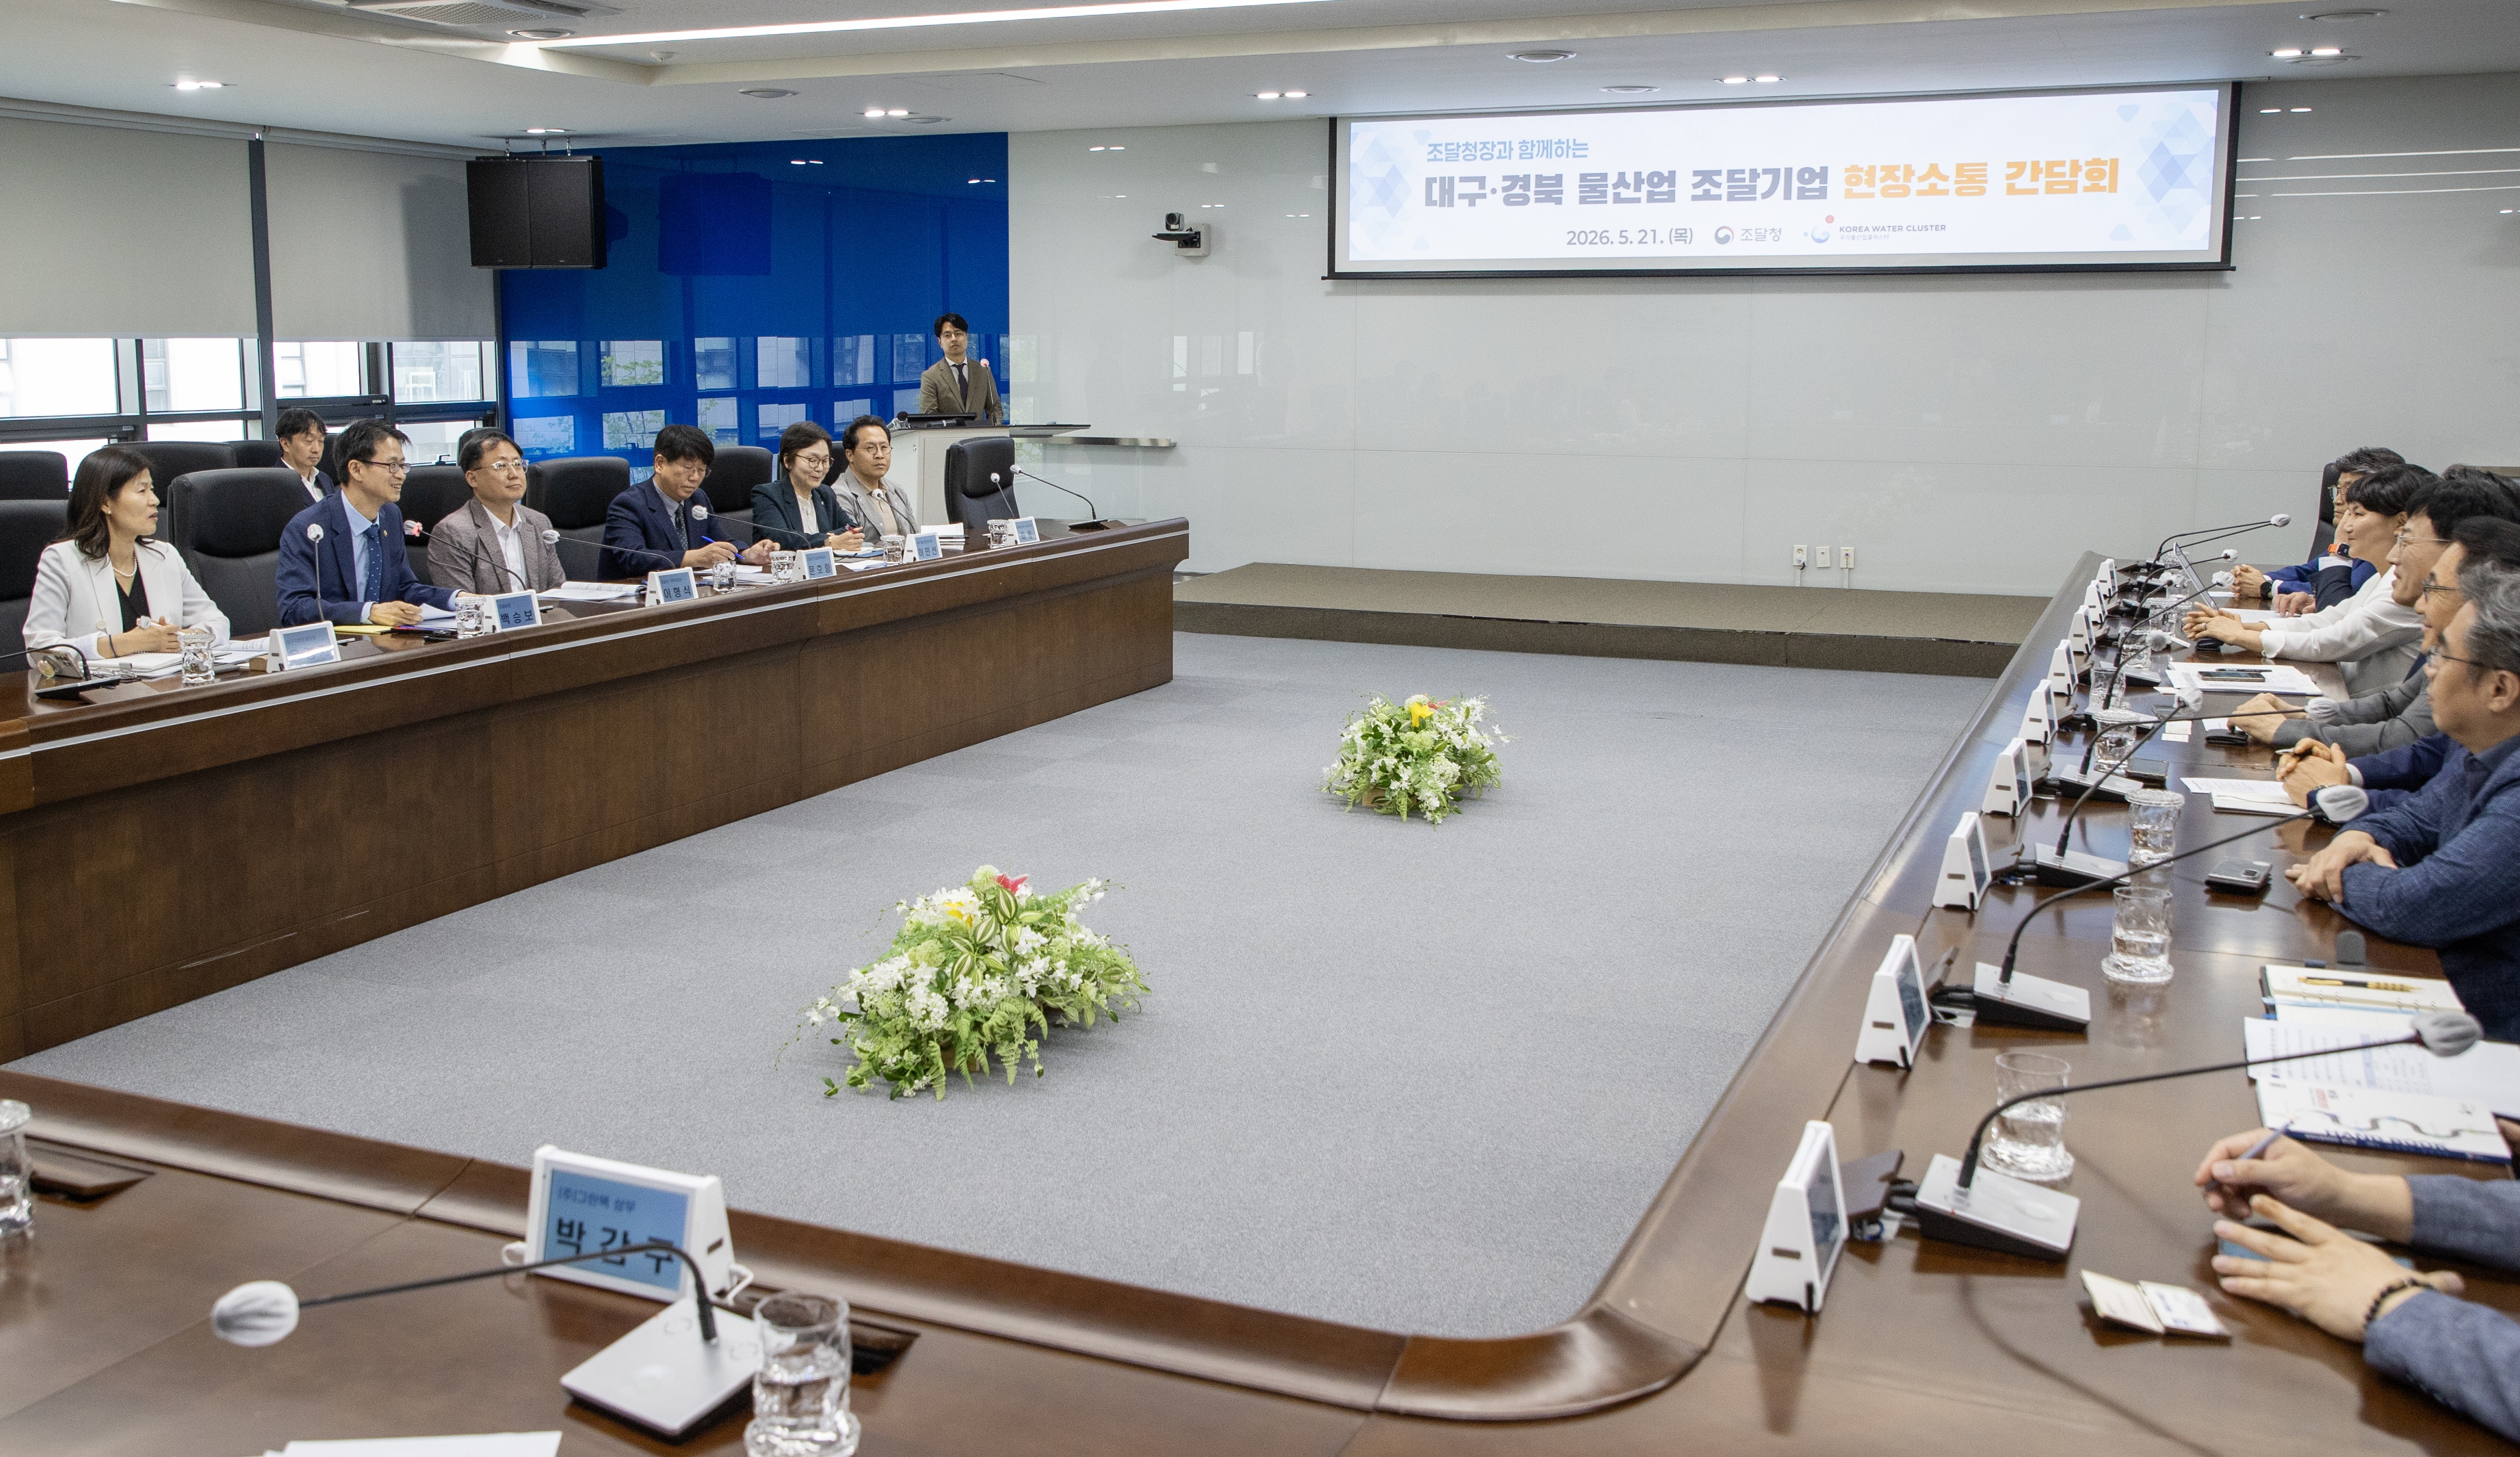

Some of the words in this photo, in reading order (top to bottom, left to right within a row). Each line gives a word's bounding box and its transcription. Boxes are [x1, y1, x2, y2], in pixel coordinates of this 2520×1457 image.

[1426, 140, 1514, 163] 조달청장과
[1518, 138, 1589, 160] 함께하는
[1424, 173, 1564, 208] 대구·경북
[1578, 170, 1676, 205] 물산업
[1690, 166, 1829, 202] 조달기업
[1843, 162, 1988, 199] 현장소통
[2005, 157, 2120, 196] 간담회
[1566, 230, 1614, 245] 2026.
[1617, 230, 1633, 245] 5.
[1637, 229, 1664, 245] 21.
[1668, 227, 1693, 245] (목)
[1740, 226, 1783, 242] 조달청
